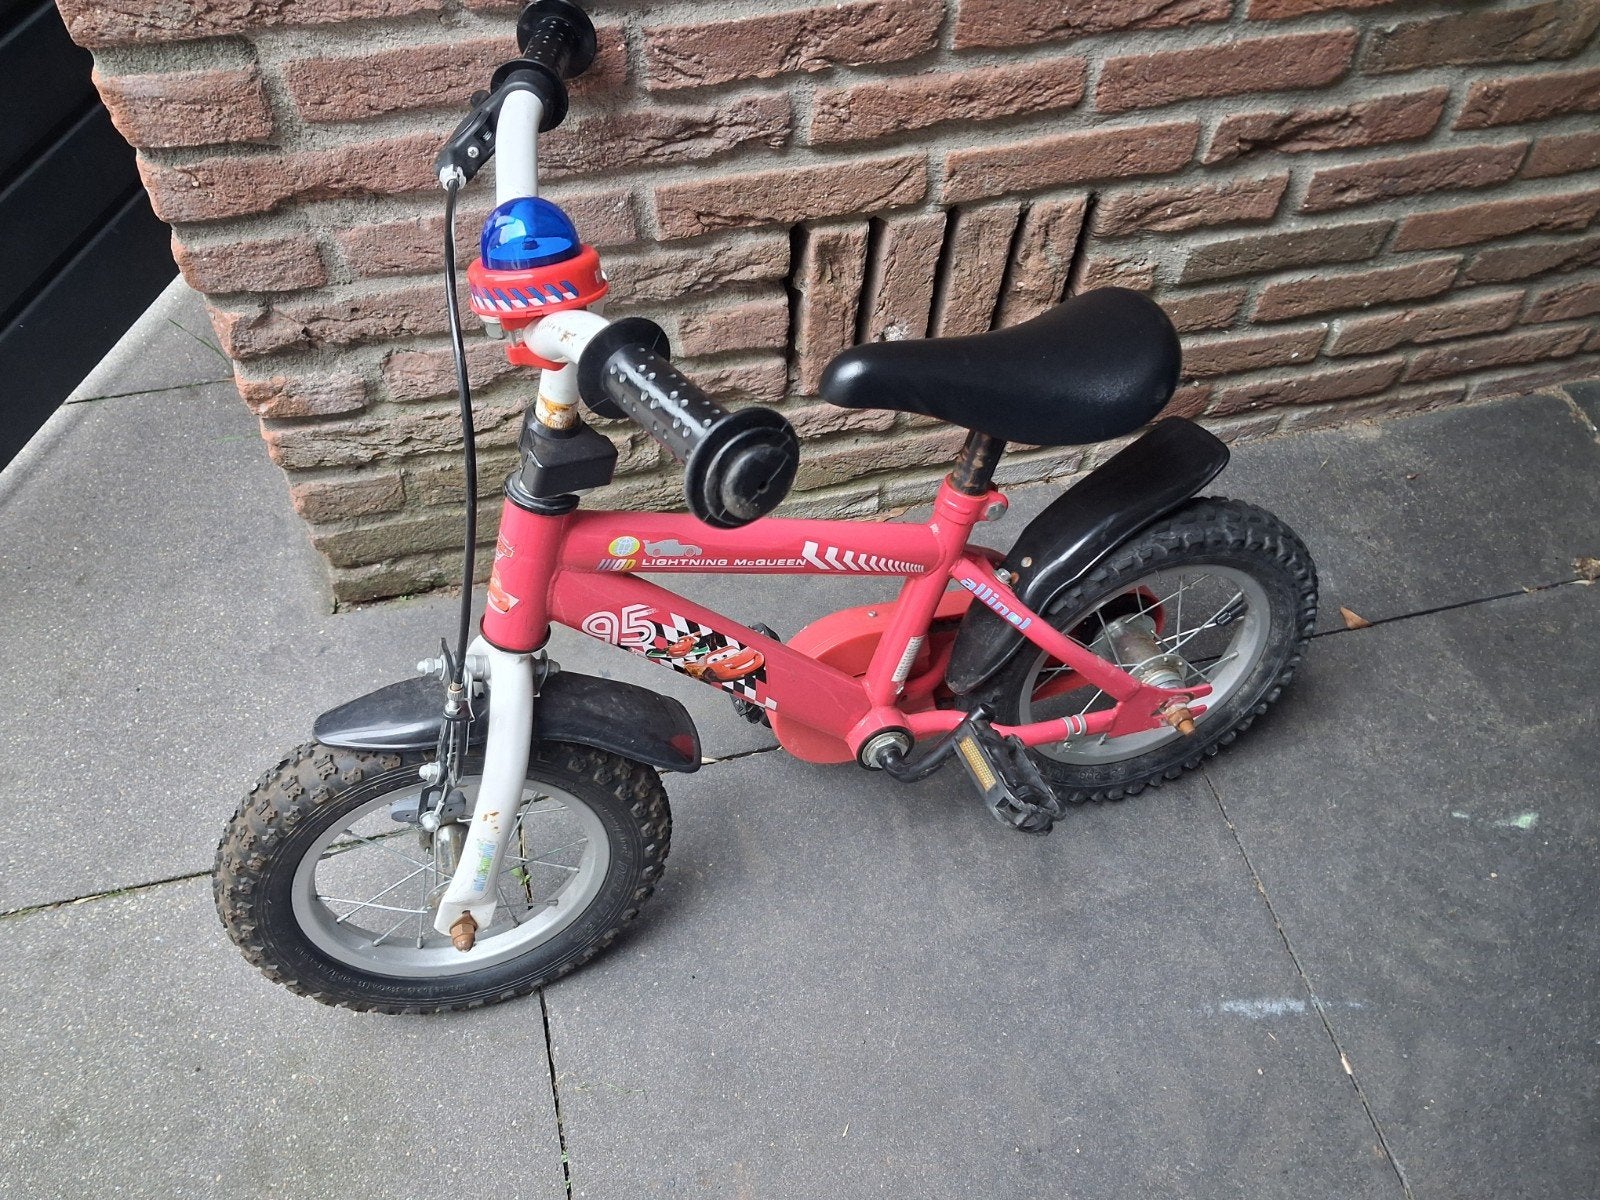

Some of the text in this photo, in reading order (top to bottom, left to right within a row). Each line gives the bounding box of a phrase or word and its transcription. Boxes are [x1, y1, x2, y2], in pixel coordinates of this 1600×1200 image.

[641, 558, 807, 566] LIGHTNING McQUEEN
[581, 603, 656, 647] 95
